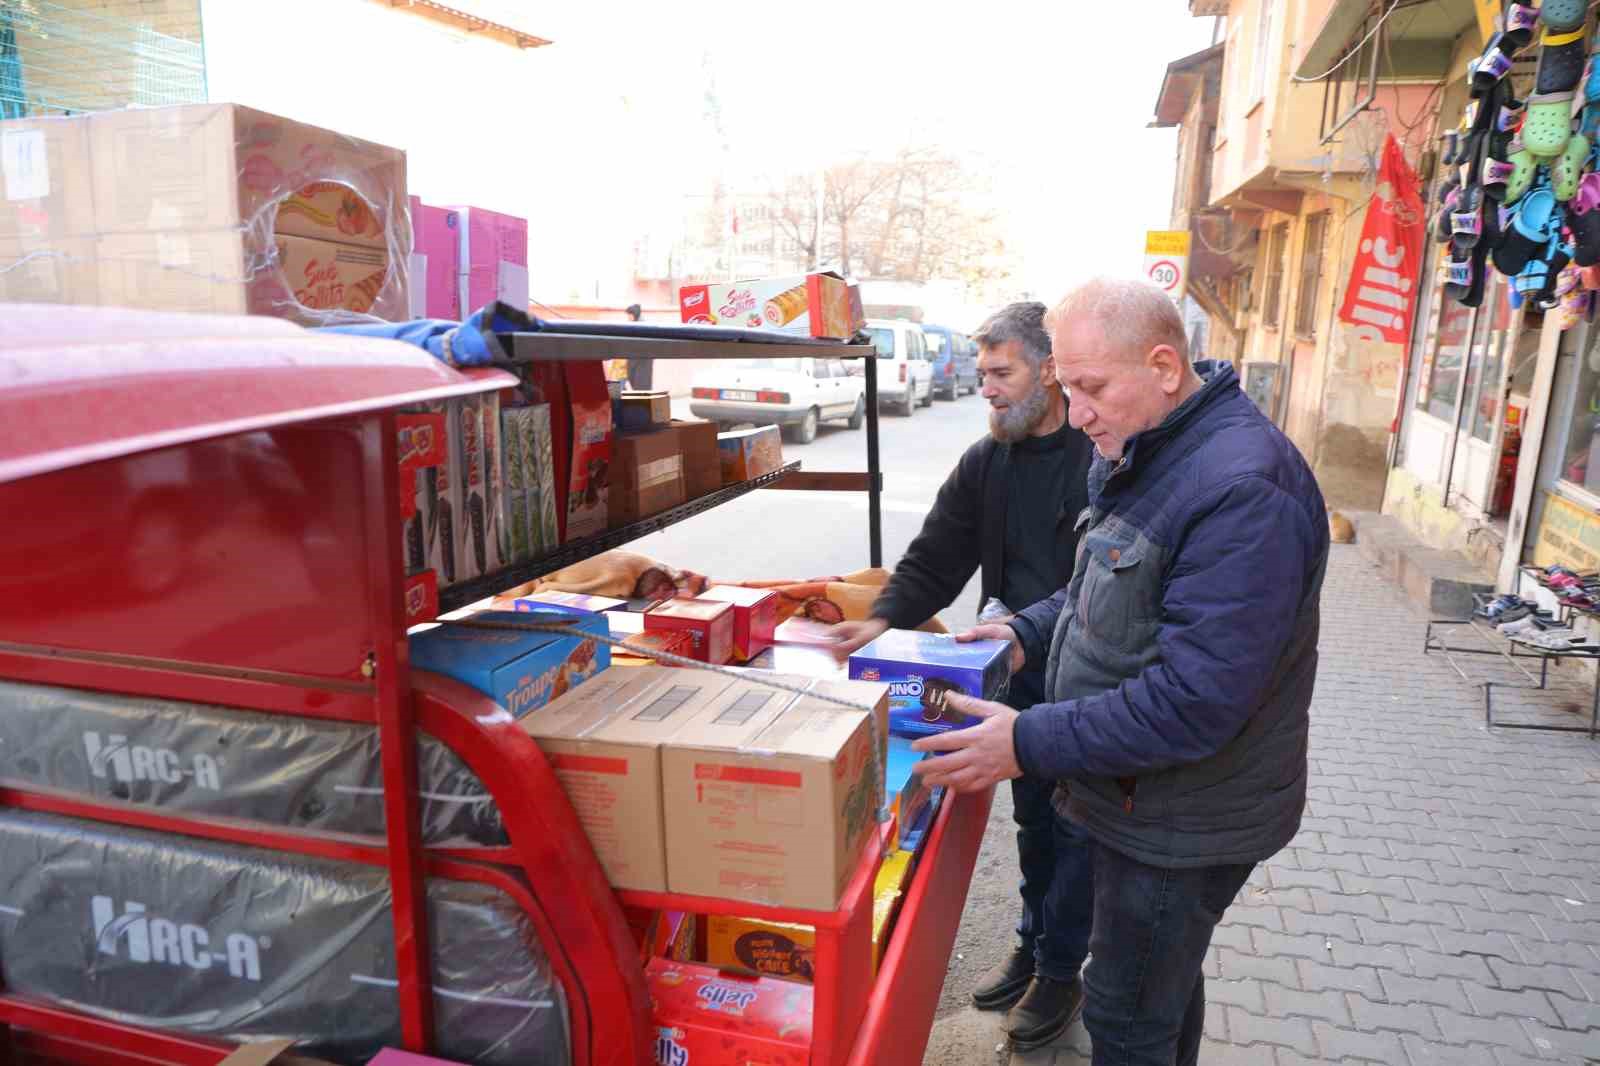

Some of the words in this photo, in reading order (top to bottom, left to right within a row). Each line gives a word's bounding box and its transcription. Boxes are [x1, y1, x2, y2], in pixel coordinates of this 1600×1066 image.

[1155, 268, 1174, 283] 30
[698, 983, 757, 1008] Jelly
[655, 1036, 688, 1066] lly
